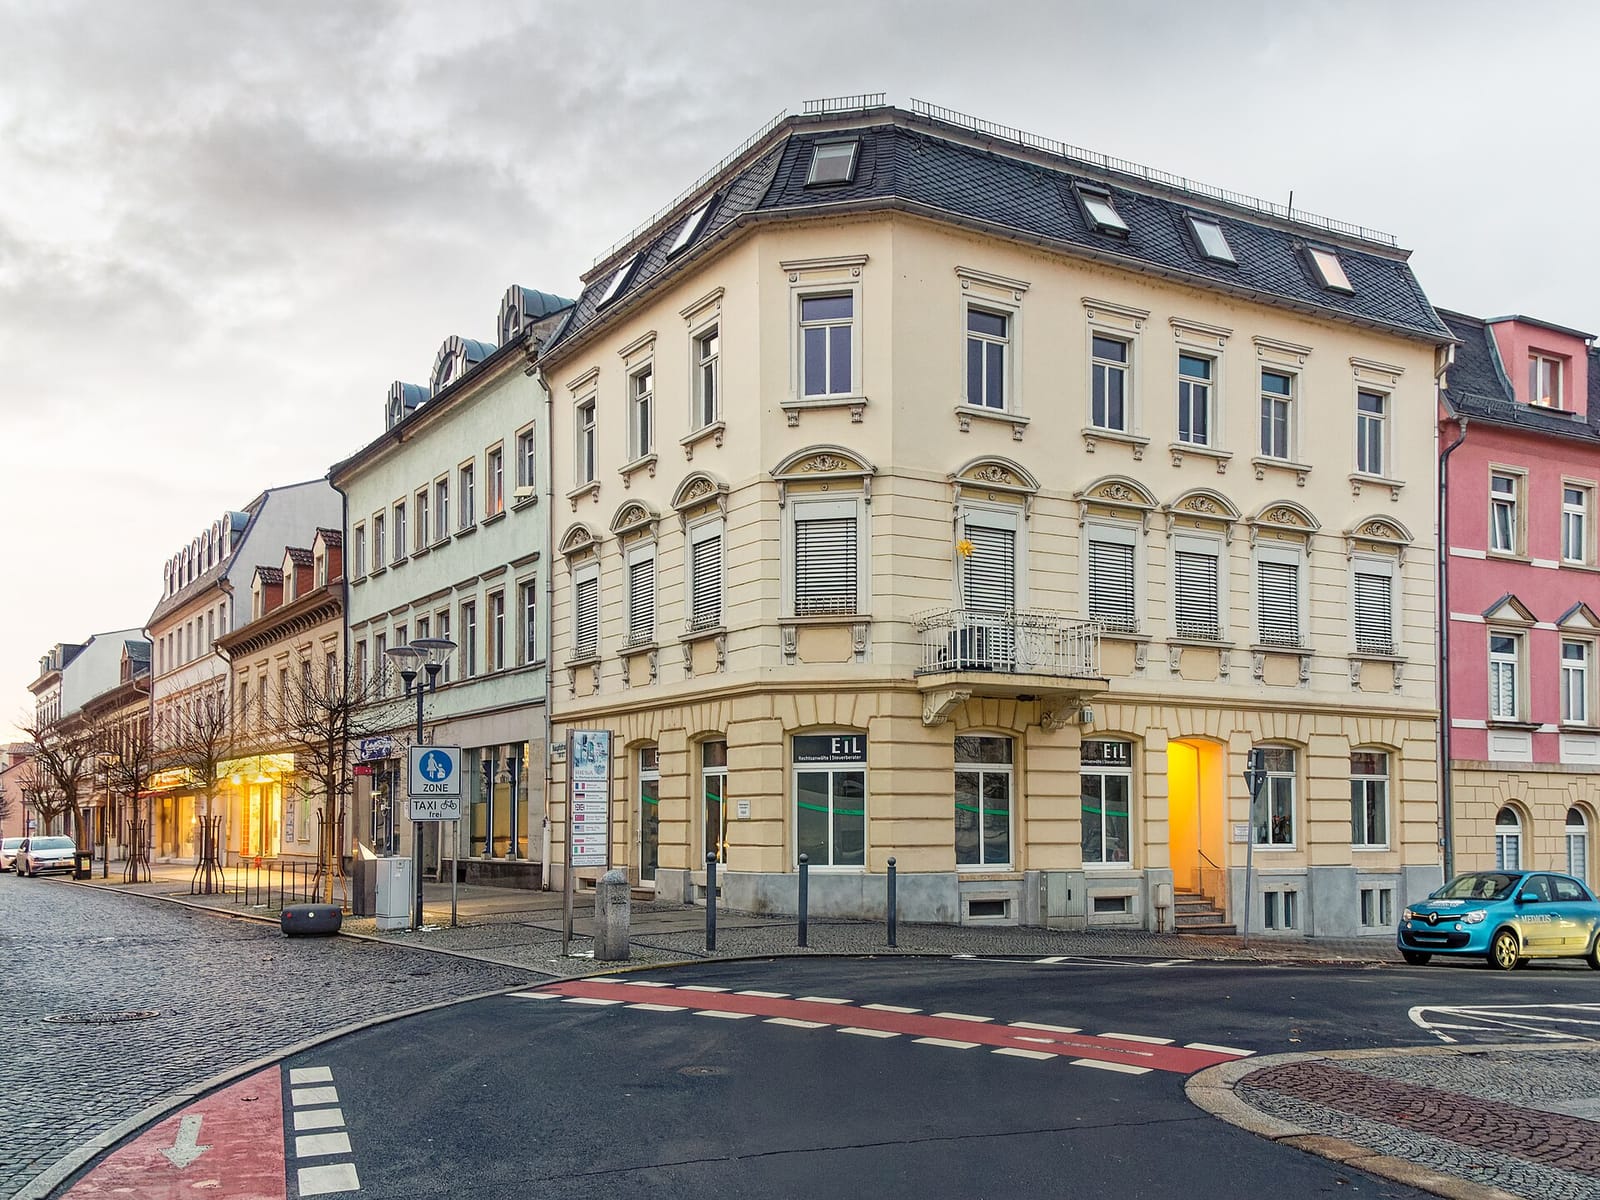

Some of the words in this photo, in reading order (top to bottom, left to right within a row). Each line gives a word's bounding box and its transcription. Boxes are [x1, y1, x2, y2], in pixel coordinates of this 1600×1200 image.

[831, 736, 862, 753] ETL
[423, 783, 449, 793] ZONE
[413, 800, 437, 810] TAXI
[429, 810, 442, 818] frei
